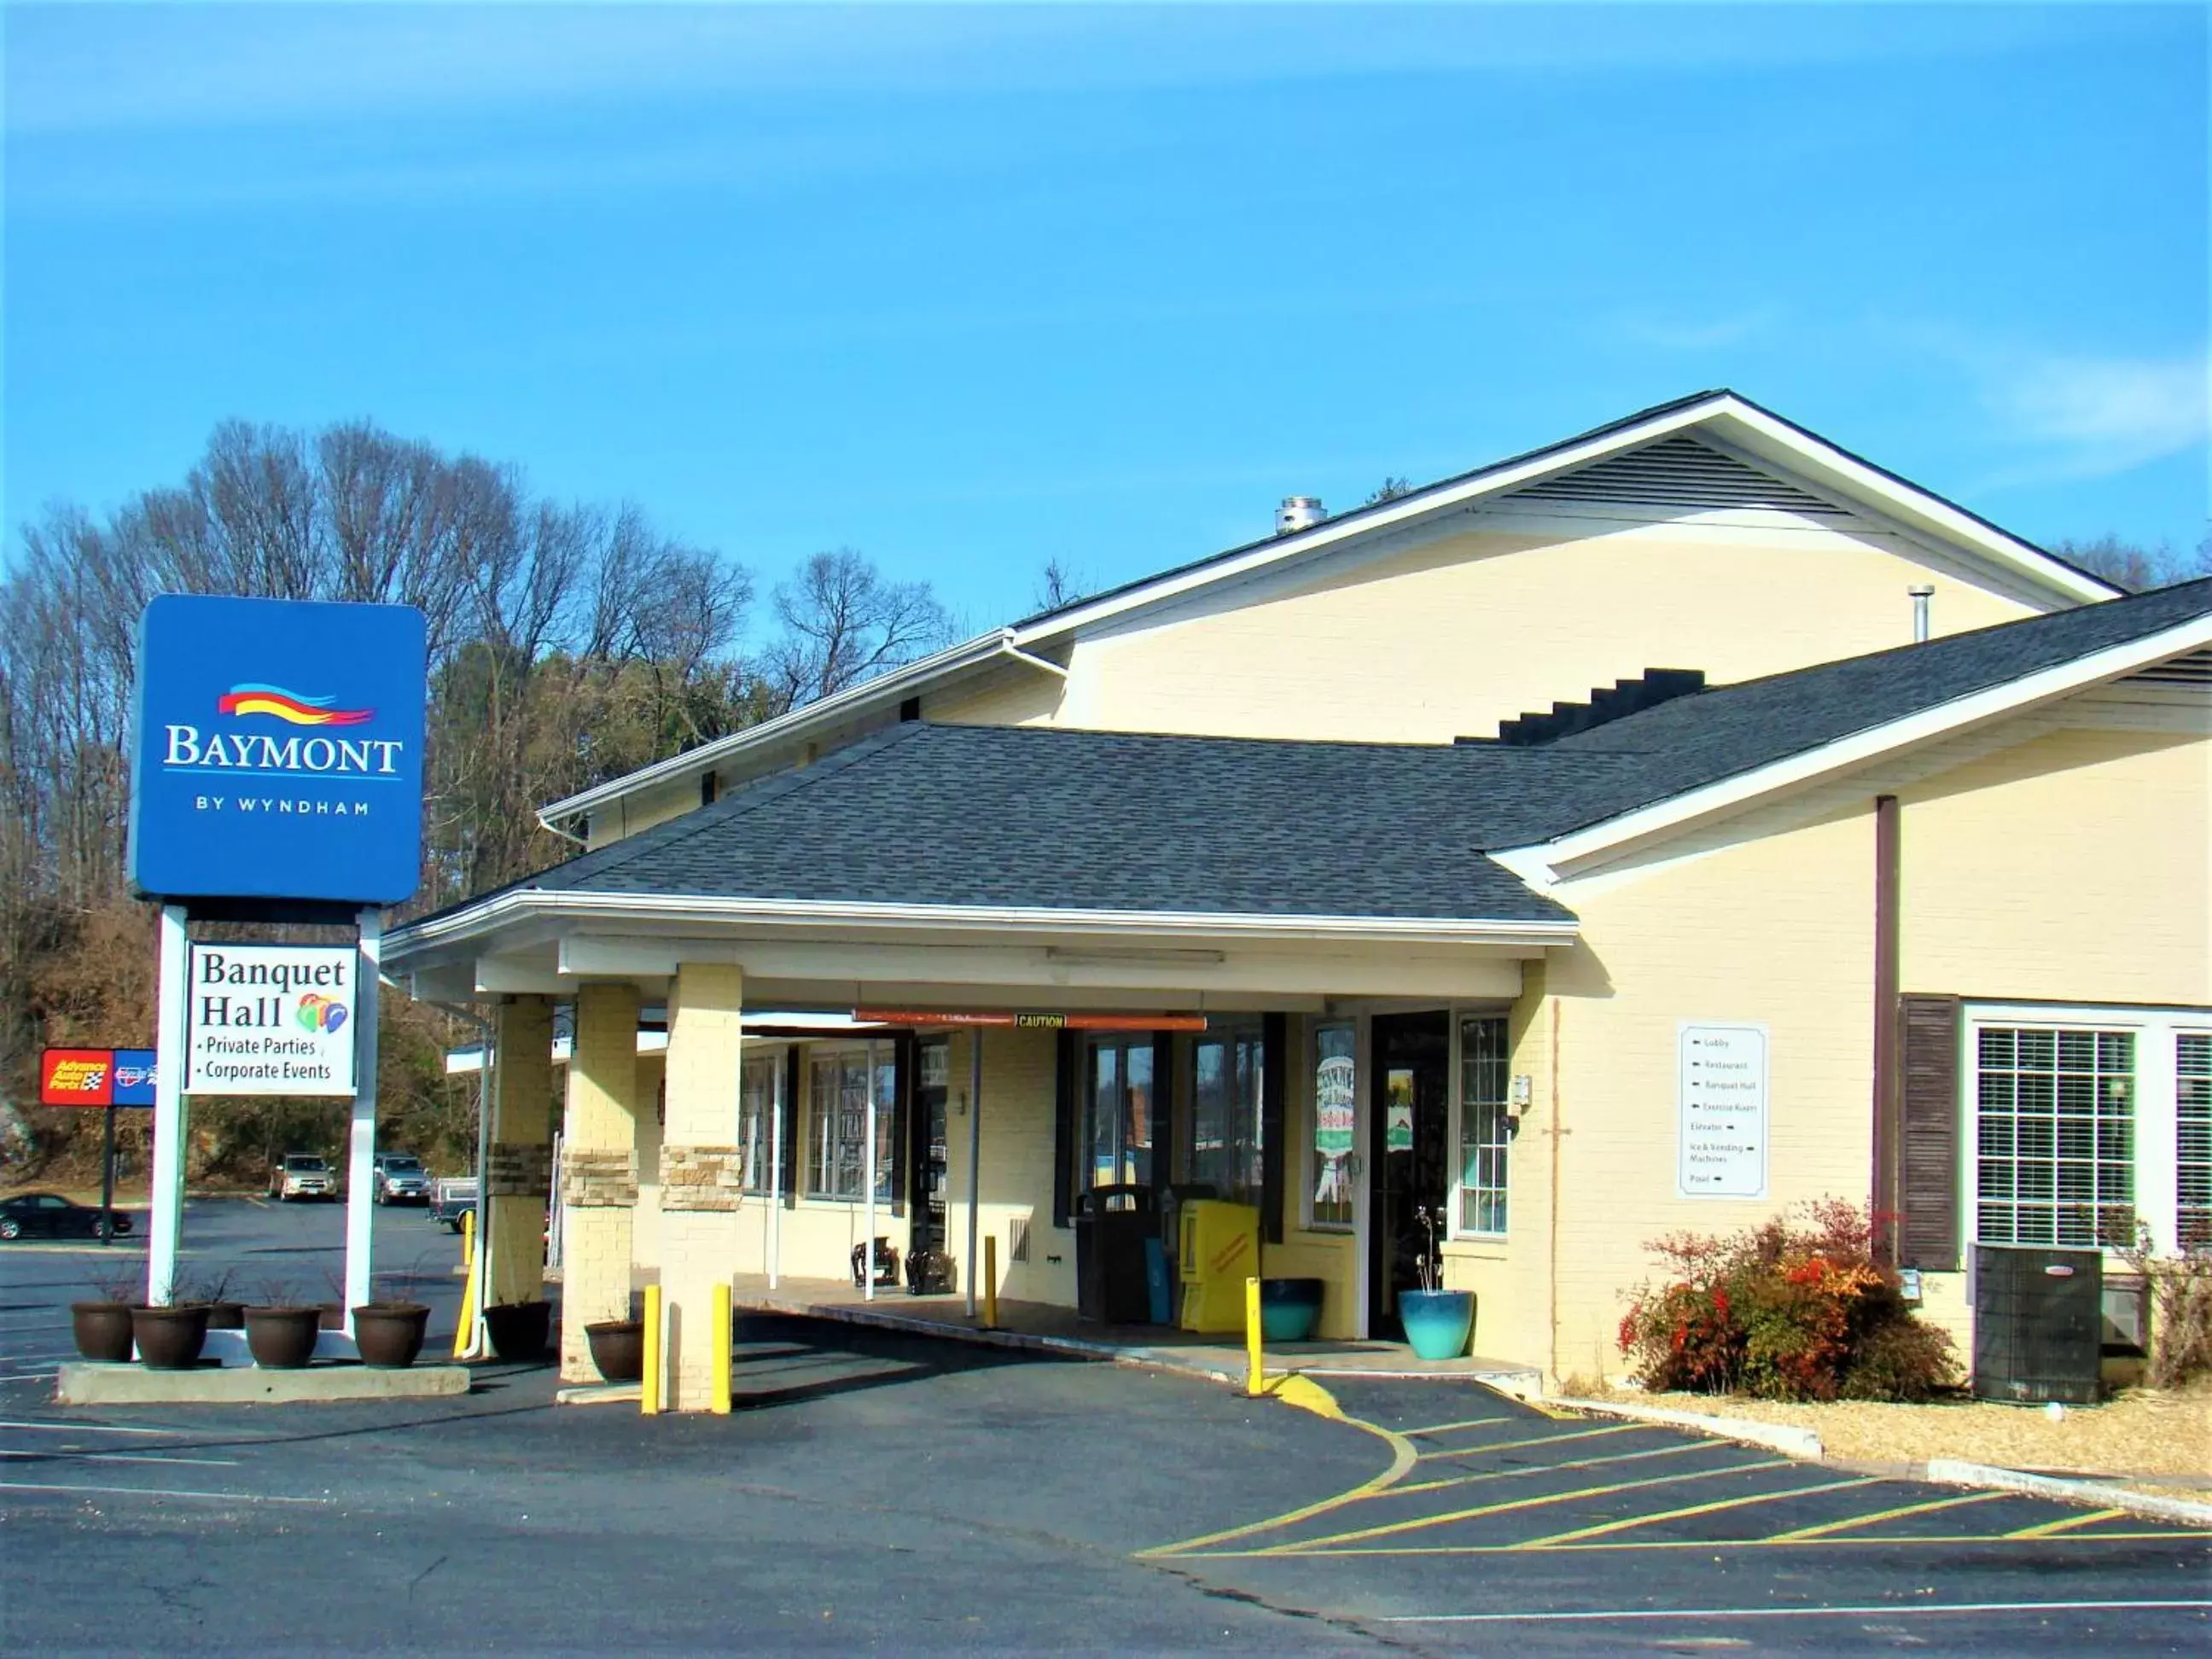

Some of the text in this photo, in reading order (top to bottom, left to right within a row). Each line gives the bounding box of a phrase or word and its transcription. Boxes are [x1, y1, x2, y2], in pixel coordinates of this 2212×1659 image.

[163, 725, 403, 772] BAYMONT
[195, 795, 369, 816] BY WYNDHAM
[201, 952, 346, 993] Banquet
[201, 996, 282, 1027] Hall
[1019, 1016, 1062, 1027] CAUTION
[207, 1035, 316, 1056] Private Parties
[1704, 1039, 1729, 1048] Lobby
[55, 1060, 108, 1072] Advance
[1705, 1061, 1748, 1069] Restaurant
[51, 1070, 84, 1081] Auto
[206, 1061, 331, 1082] Corporate Events
[1691, 1122, 1722, 1131] Elevator
[1709, 1144, 1743, 1154] Vending
